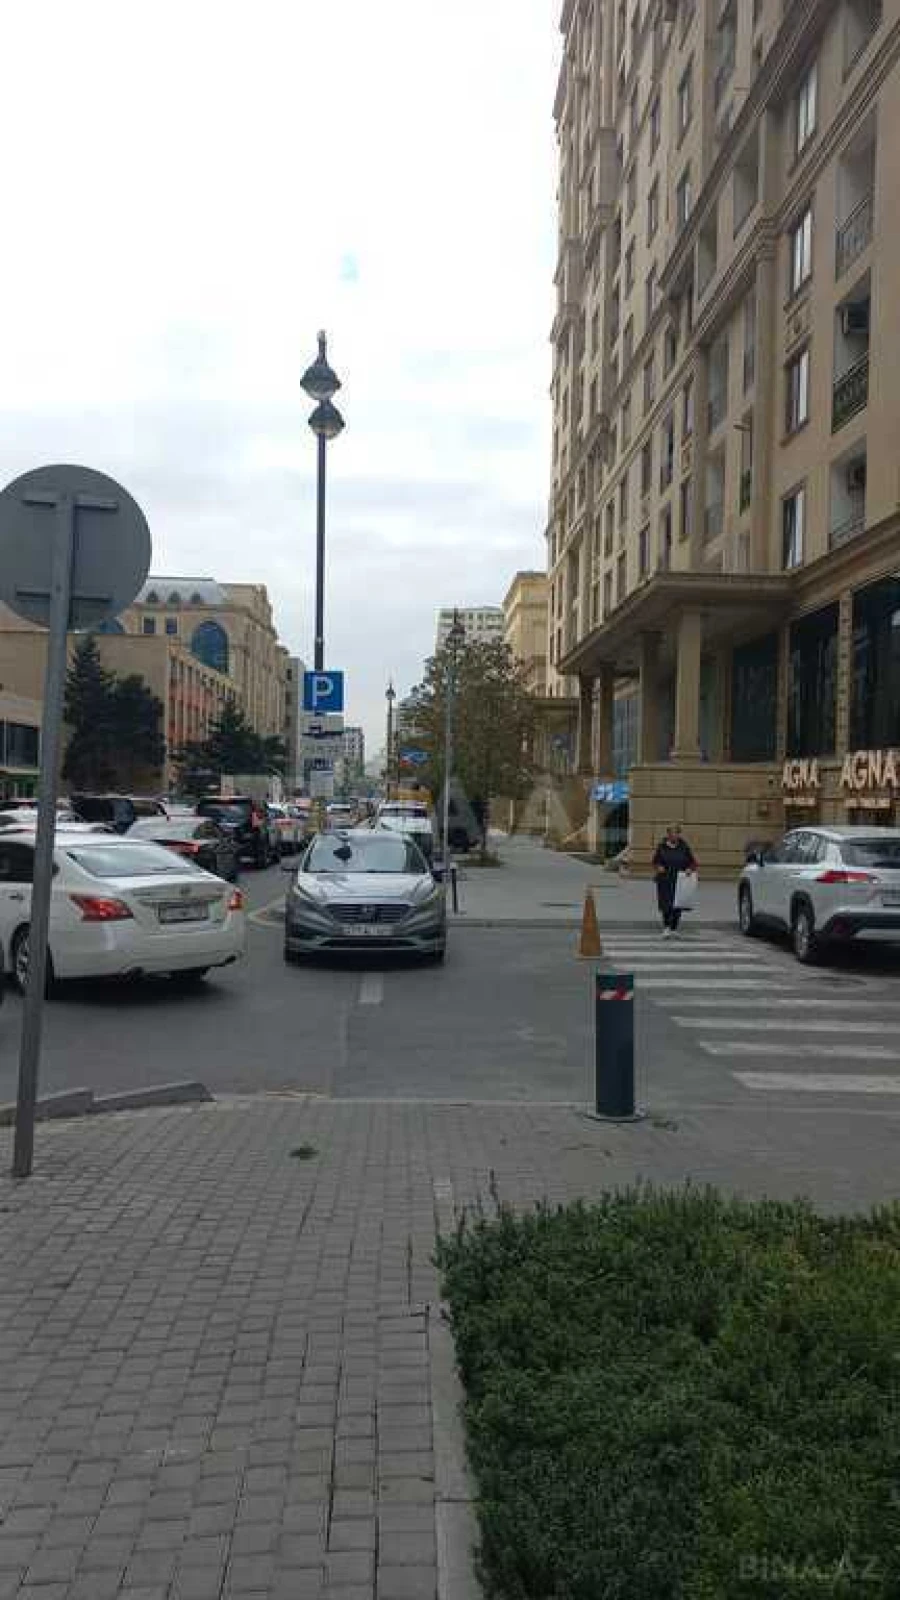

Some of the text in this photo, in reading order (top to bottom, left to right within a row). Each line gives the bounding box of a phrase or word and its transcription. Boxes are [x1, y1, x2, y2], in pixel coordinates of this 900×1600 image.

[312, 676, 334, 706] P
[781, 758, 821, 789] AGNA
[840, 749, 898, 790] AGNA
